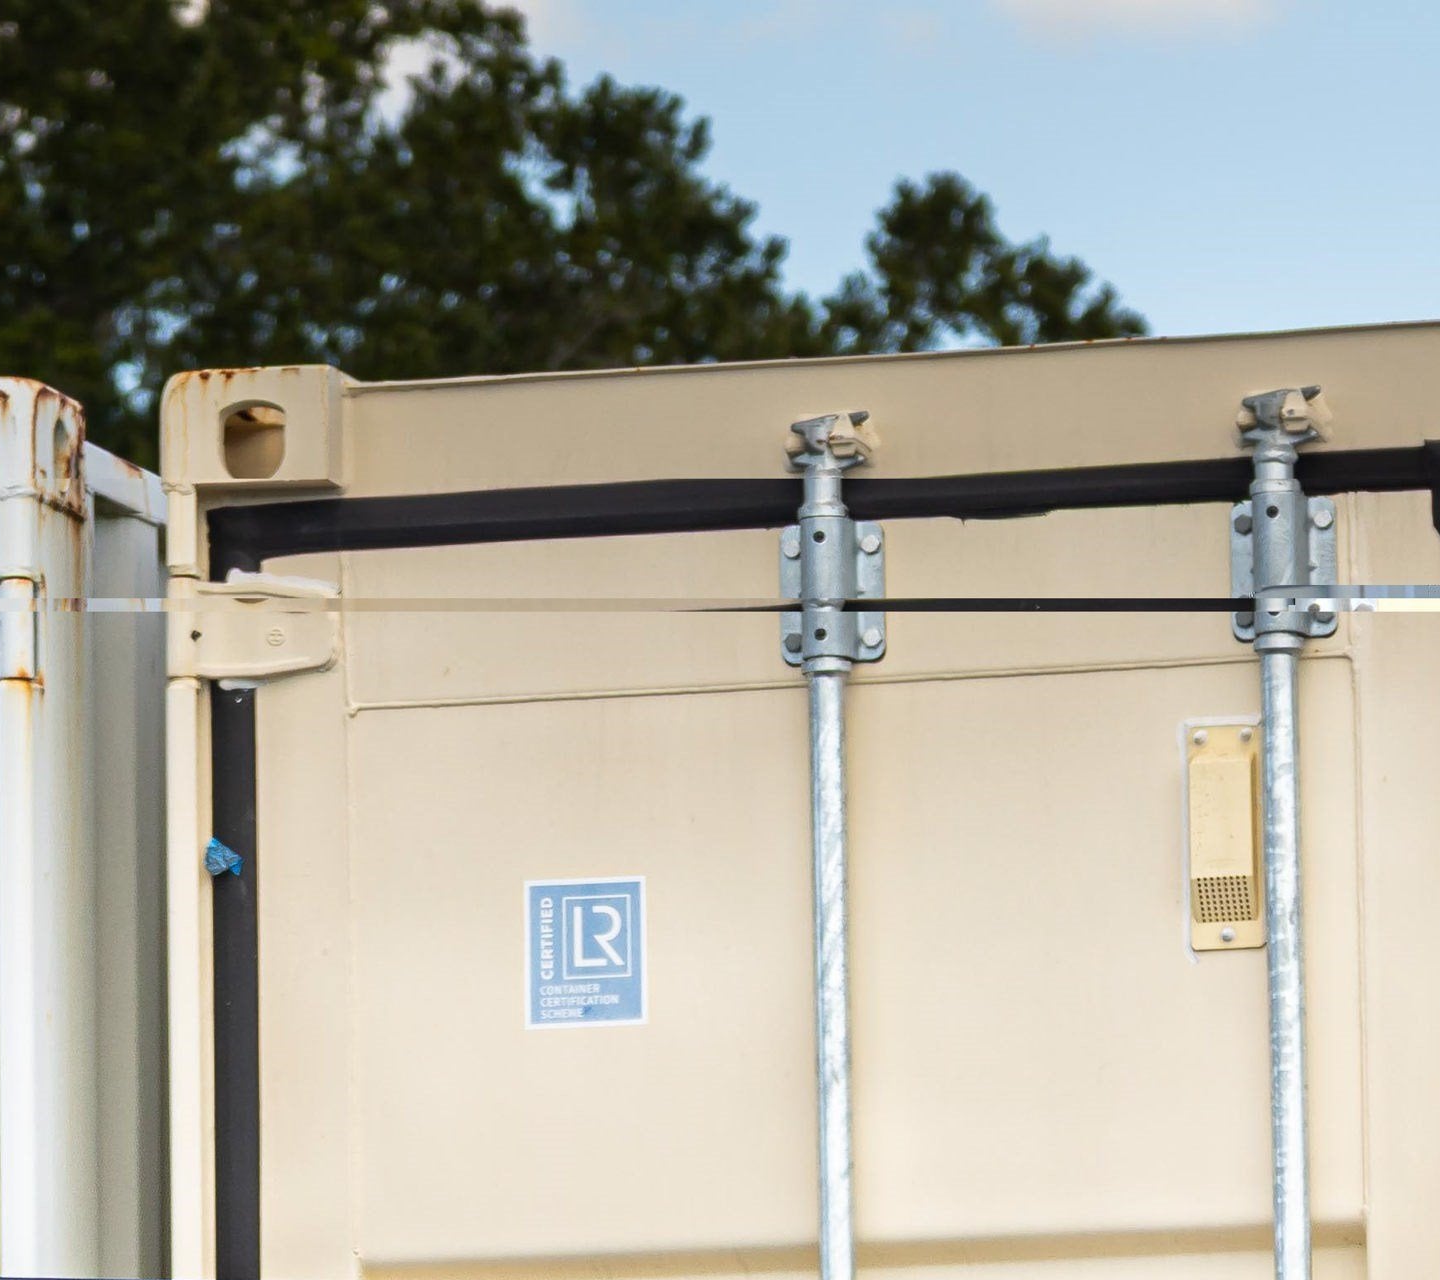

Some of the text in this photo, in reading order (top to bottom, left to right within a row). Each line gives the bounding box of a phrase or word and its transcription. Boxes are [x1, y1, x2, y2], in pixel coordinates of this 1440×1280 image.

[540, 896, 554, 981] CERTIFIED
[573, 905, 625, 968] LR
[539, 983, 601, 996] CONTAINER
[539, 994, 620, 1008] CERTIFICATION
